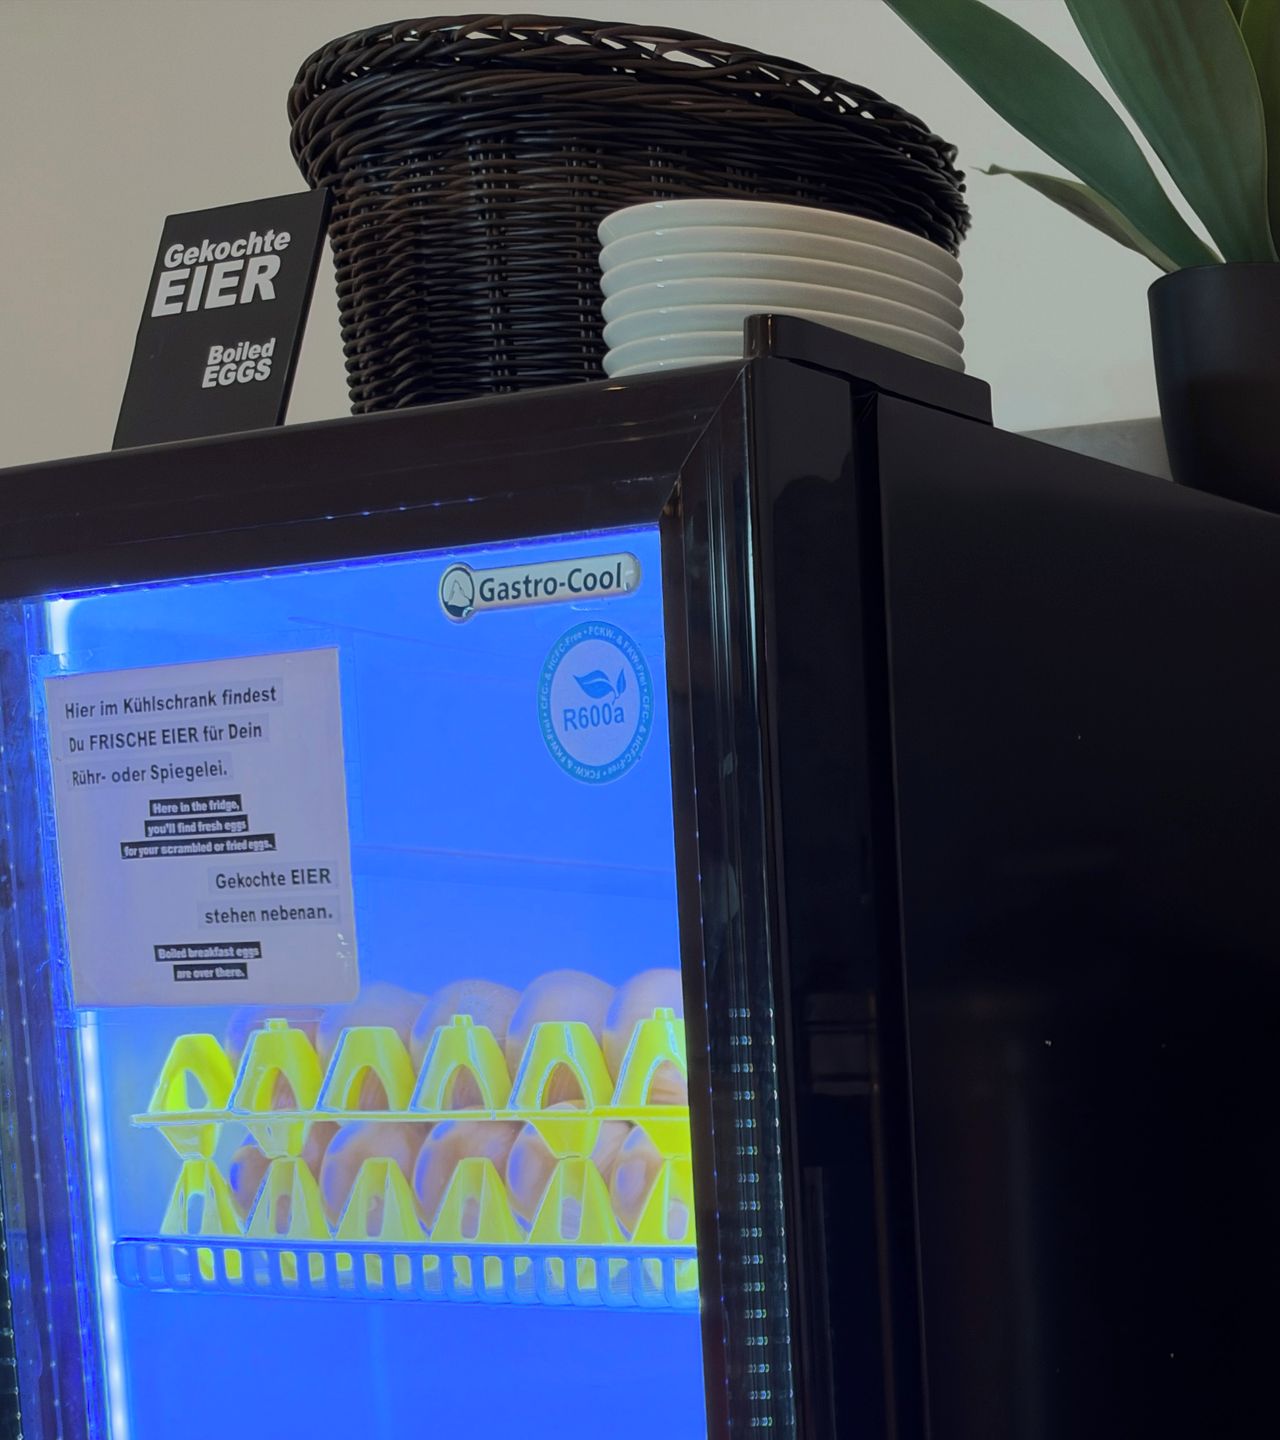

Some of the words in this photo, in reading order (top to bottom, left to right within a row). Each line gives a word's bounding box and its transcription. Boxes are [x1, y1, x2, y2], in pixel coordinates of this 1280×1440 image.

[164, 229, 291, 268] Gekochte
[151, 254, 281, 318] EIER
[207, 337, 276, 365] Boiled
[202, 358, 272, 388] EGGS
[479, 562, 622, 602] Gastro-Cool
[65, 702, 95, 719] Hier
[100, 700, 118, 716] im
[124, 690, 218, 714] Kühlschrank
[222, 686, 277, 705] findest
[563, 703, 625, 731] R600a
[69, 736, 84, 753] Du
[90, 730, 157, 751] FRISCHE
[162, 727, 199, 745] EIER
[203, 725, 224, 742] für
[228, 722, 262, 740] Dein
[72, 770, 106, 787] Rühr-
[112, 767, 146, 783] oder
[150, 759, 228, 784] Spiegelei.
[152, 802, 178, 814] Here
[180, 801, 190, 812] in
[191, 800, 208, 812] the
[209, 799, 240, 812] fridge,
[177, 821, 196, 834] find
[198, 820, 222, 832] fresh
[224, 820, 247, 833] eggs
[124, 845, 137, 857] for
[138, 846, 159, 858] your
[160, 842, 212, 855] scrambled
[214, 842, 224, 852] or
[226, 840, 247, 852] fried
[216, 870, 286, 889] Gekochte
[291, 868, 332, 886] EIER
[205, 908, 257, 924] stehen
[261, 905, 333, 922] nebenan.
